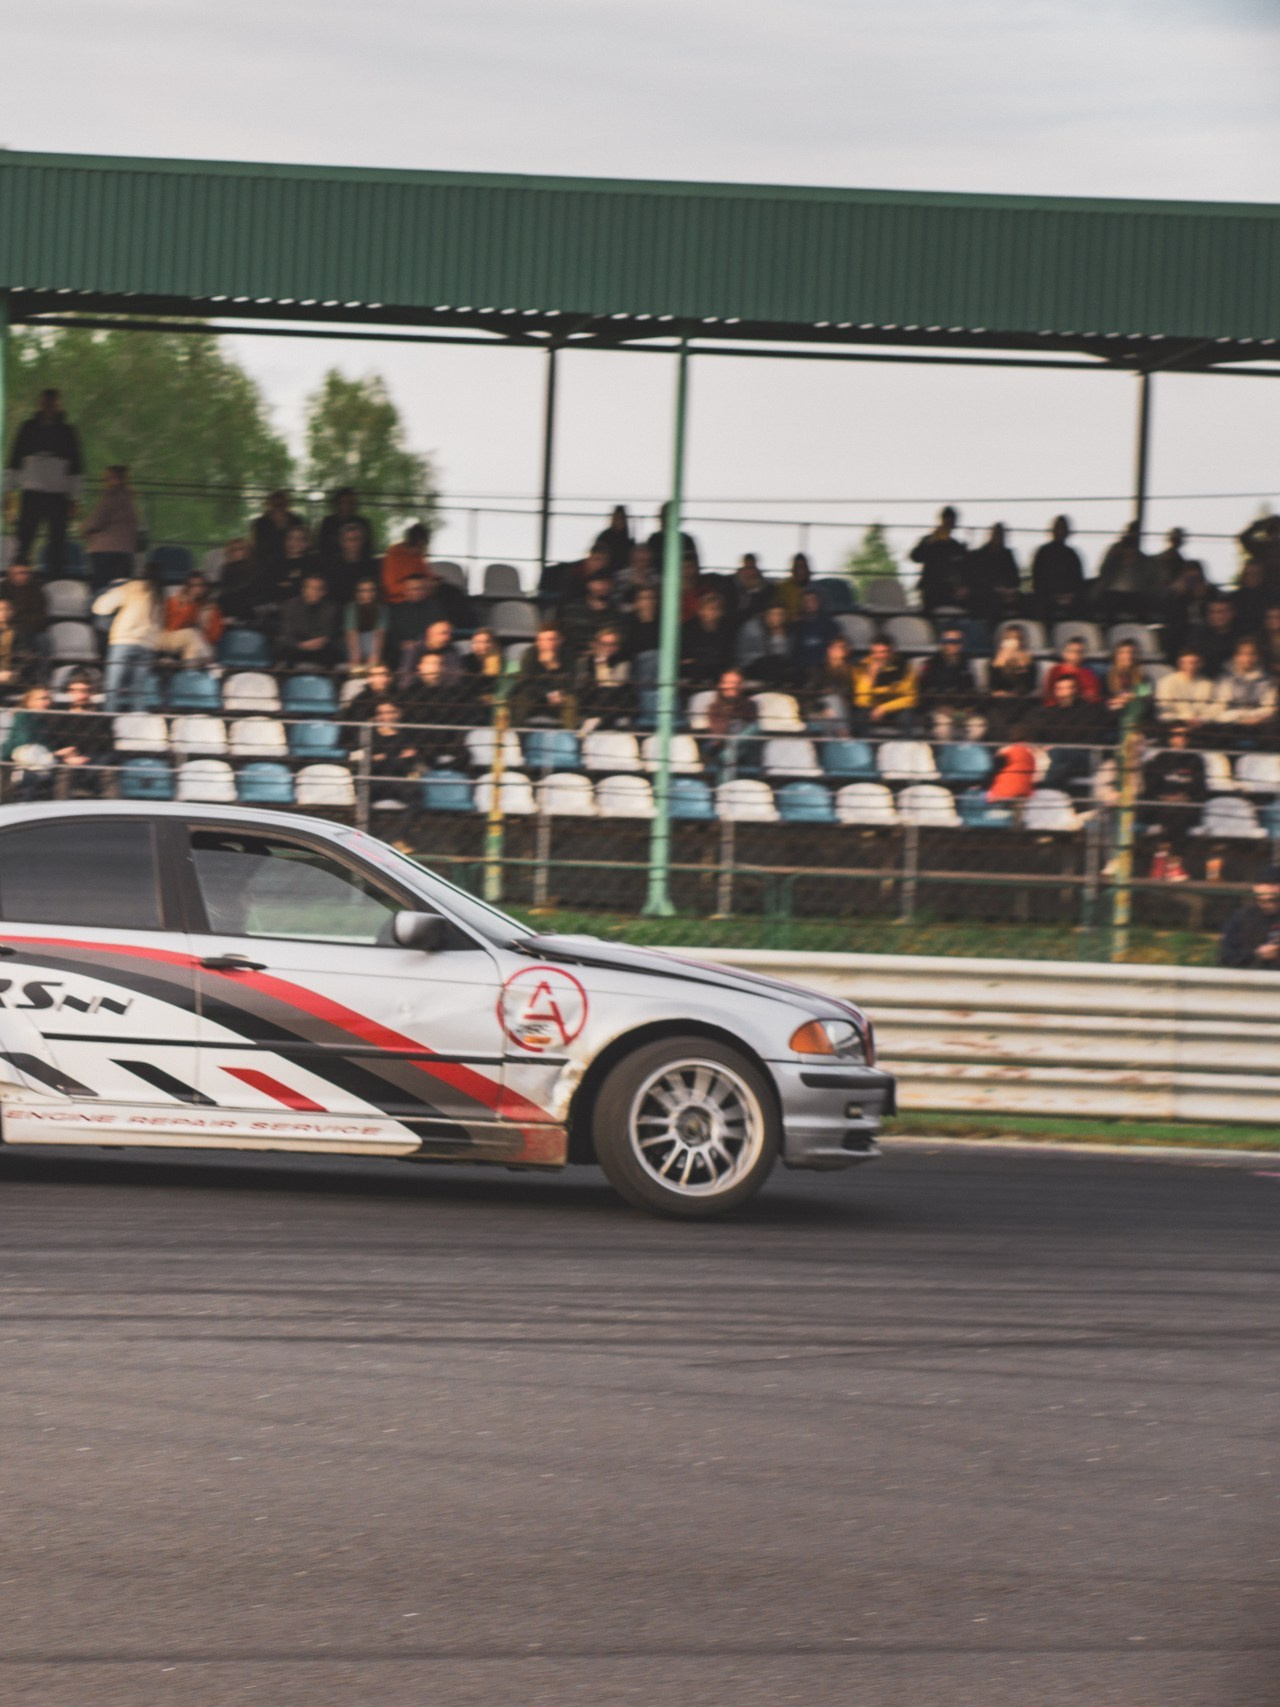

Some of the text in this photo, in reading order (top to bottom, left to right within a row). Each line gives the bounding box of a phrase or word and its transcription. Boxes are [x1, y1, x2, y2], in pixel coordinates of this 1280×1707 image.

[4, 1110, 384, 1136] ENGINE REPAIR SERVICE
